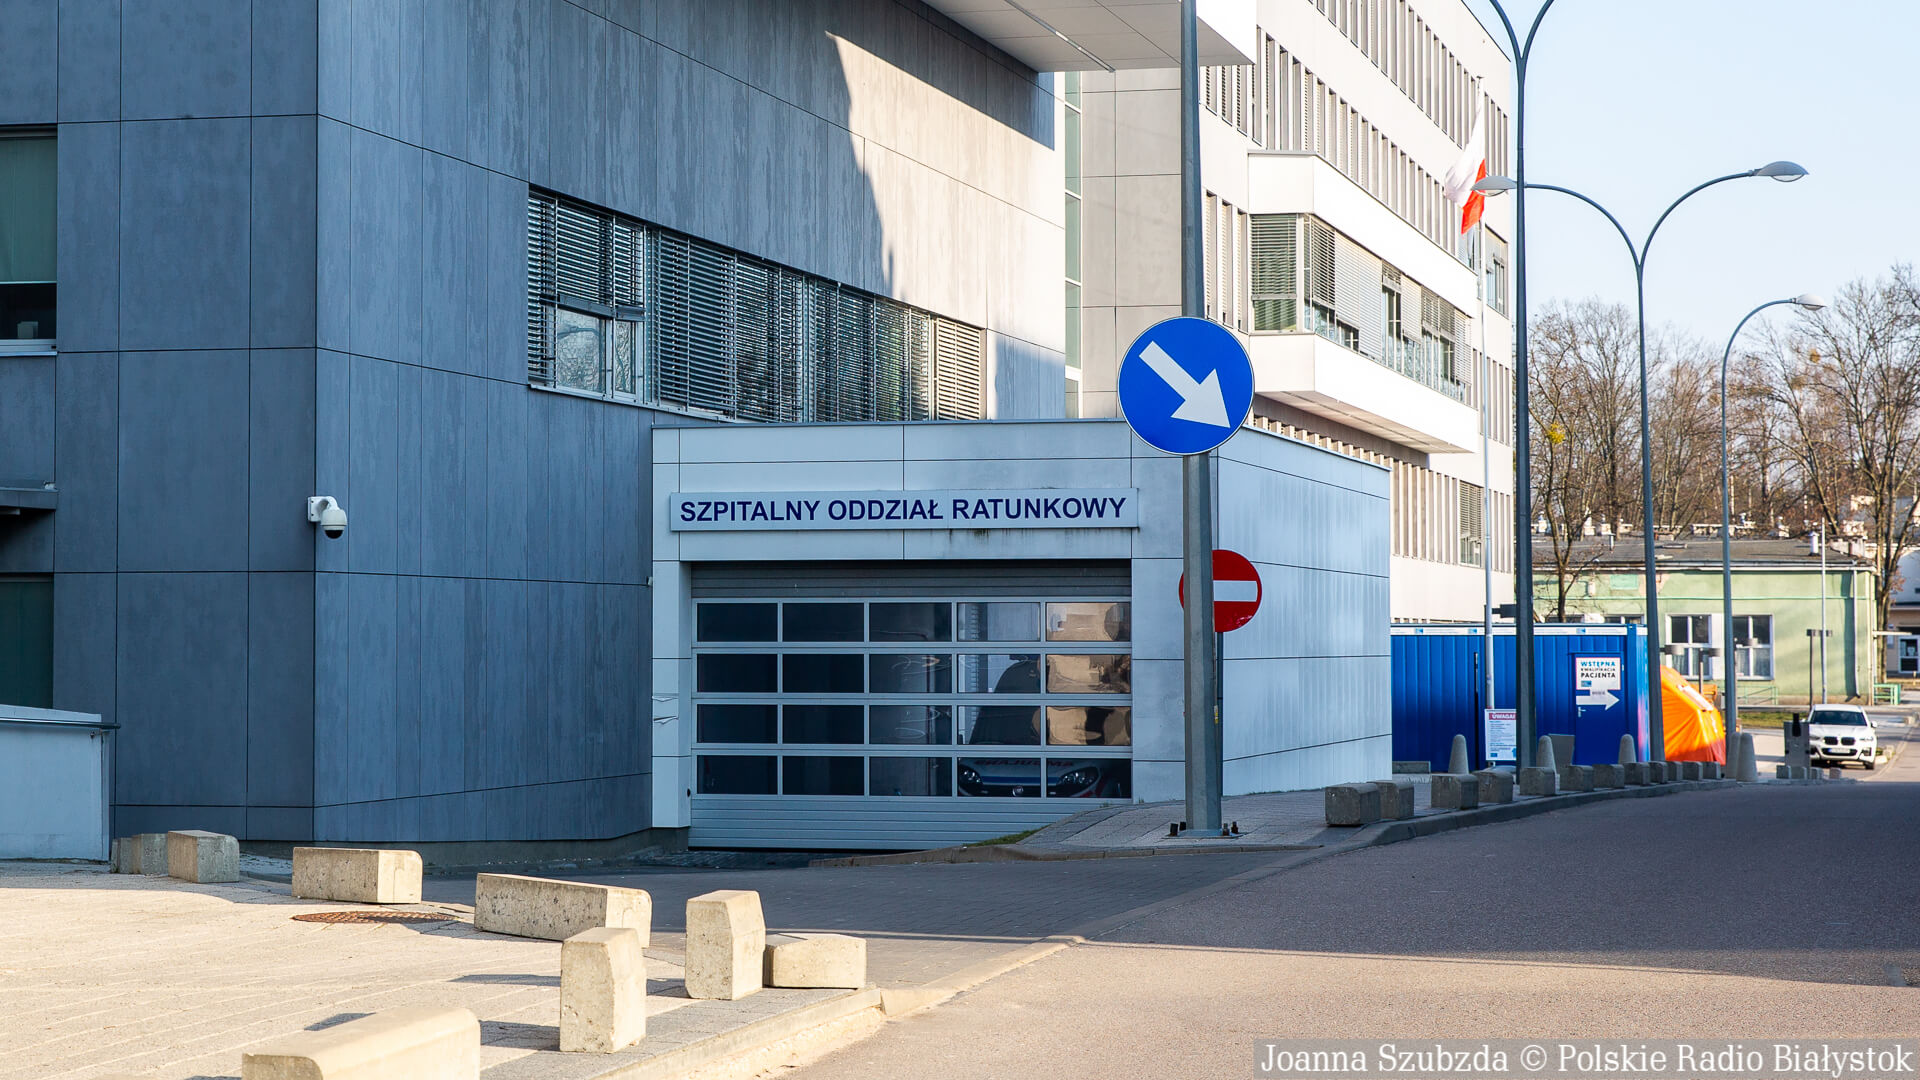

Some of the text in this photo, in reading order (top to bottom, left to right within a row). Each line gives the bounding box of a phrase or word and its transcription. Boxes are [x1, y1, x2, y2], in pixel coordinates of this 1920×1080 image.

[681, 497, 1126, 522] SZPITALNY ODDZIAŁ RATUNKOWY
